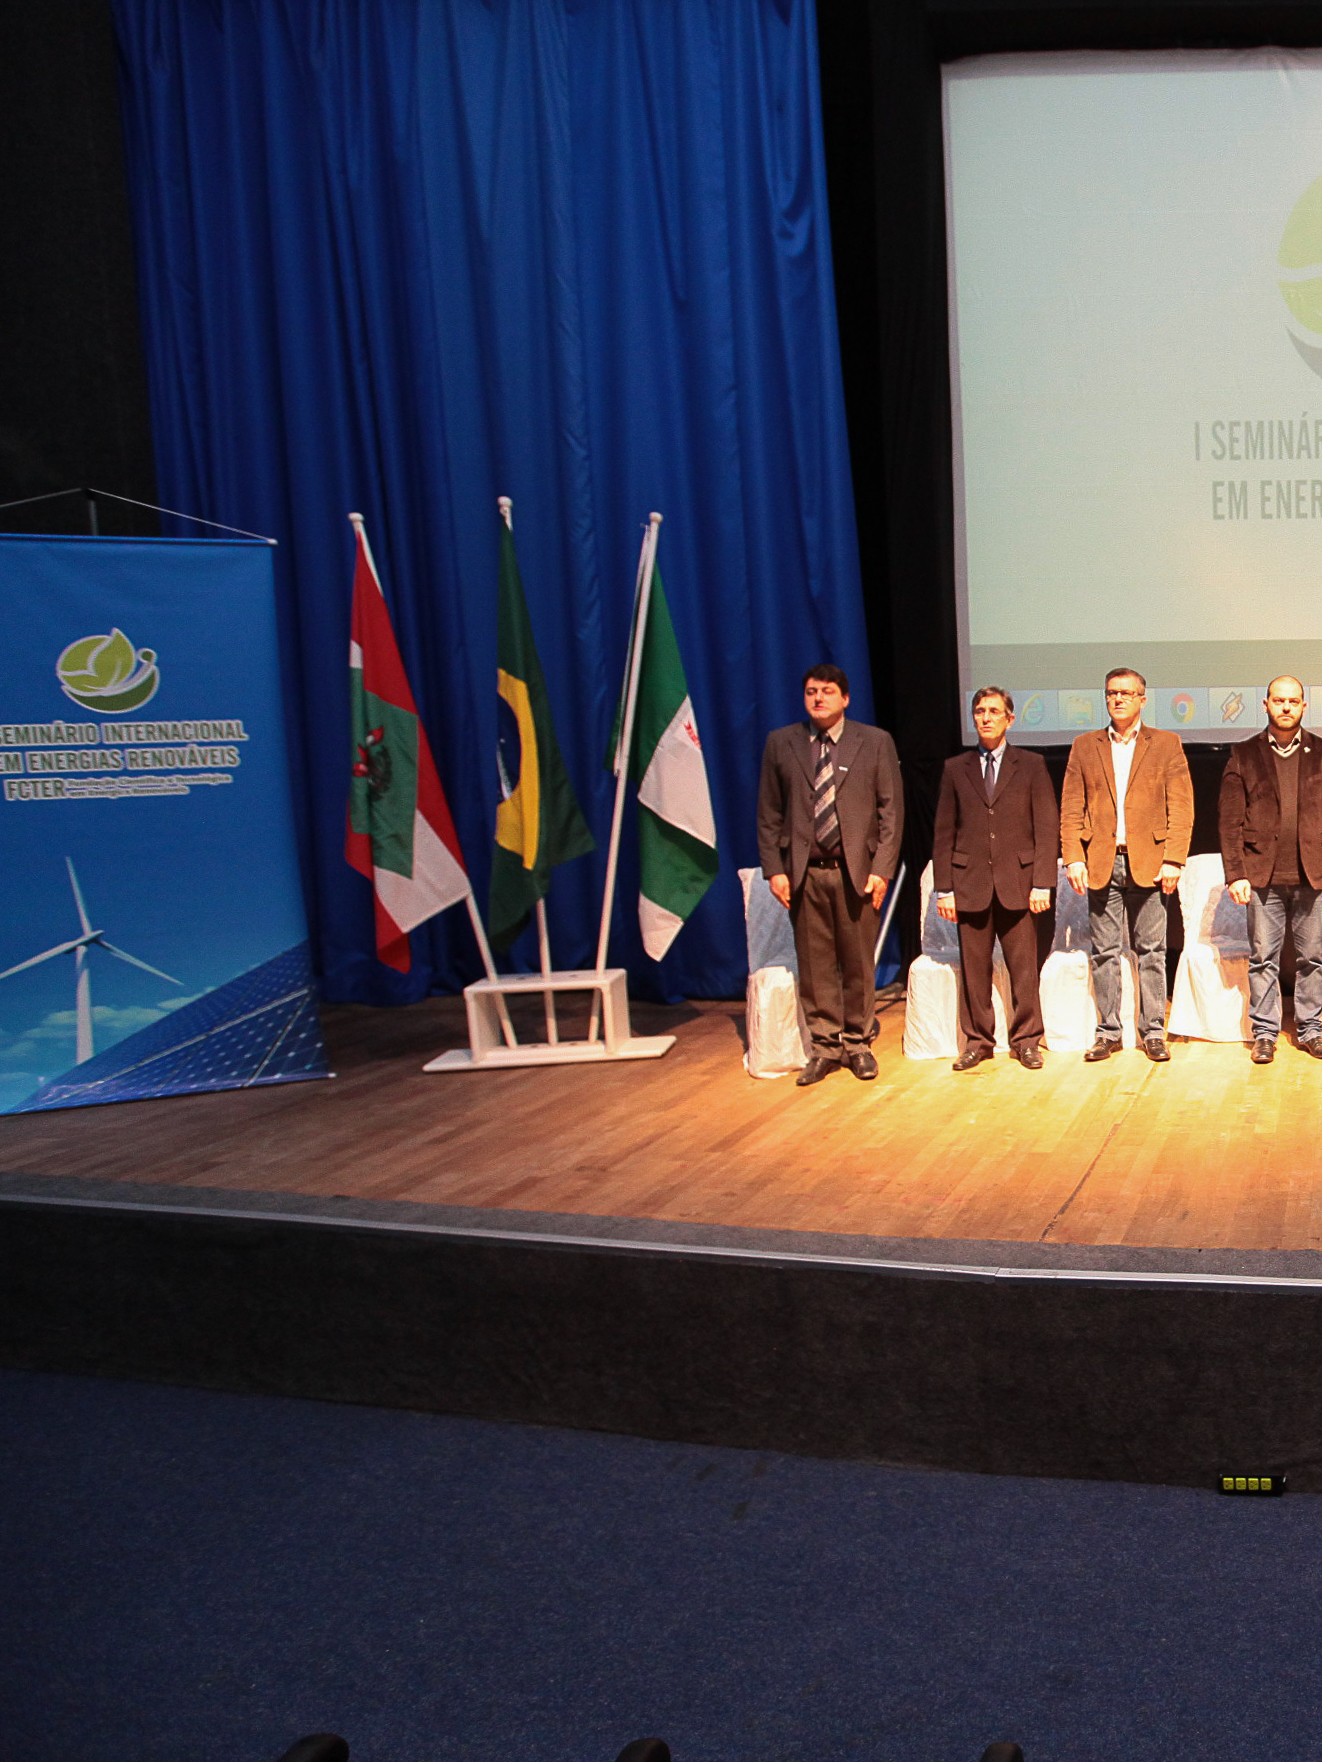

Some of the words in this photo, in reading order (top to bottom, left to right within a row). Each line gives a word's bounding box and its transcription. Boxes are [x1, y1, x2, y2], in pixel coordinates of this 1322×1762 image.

[1194, 421, 1200, 461] I
[1212, 479, 1249, 520] EM
[0, 721, 98, 745] EMINÁRIO
[103, 721, 247, 744] INTERNACIONAL
[27, 750, 122, 772] ENERGIAS
[127, 745, 239, 769] RENOVÁVEIS
[6, 779, 65, 799] FCTER
